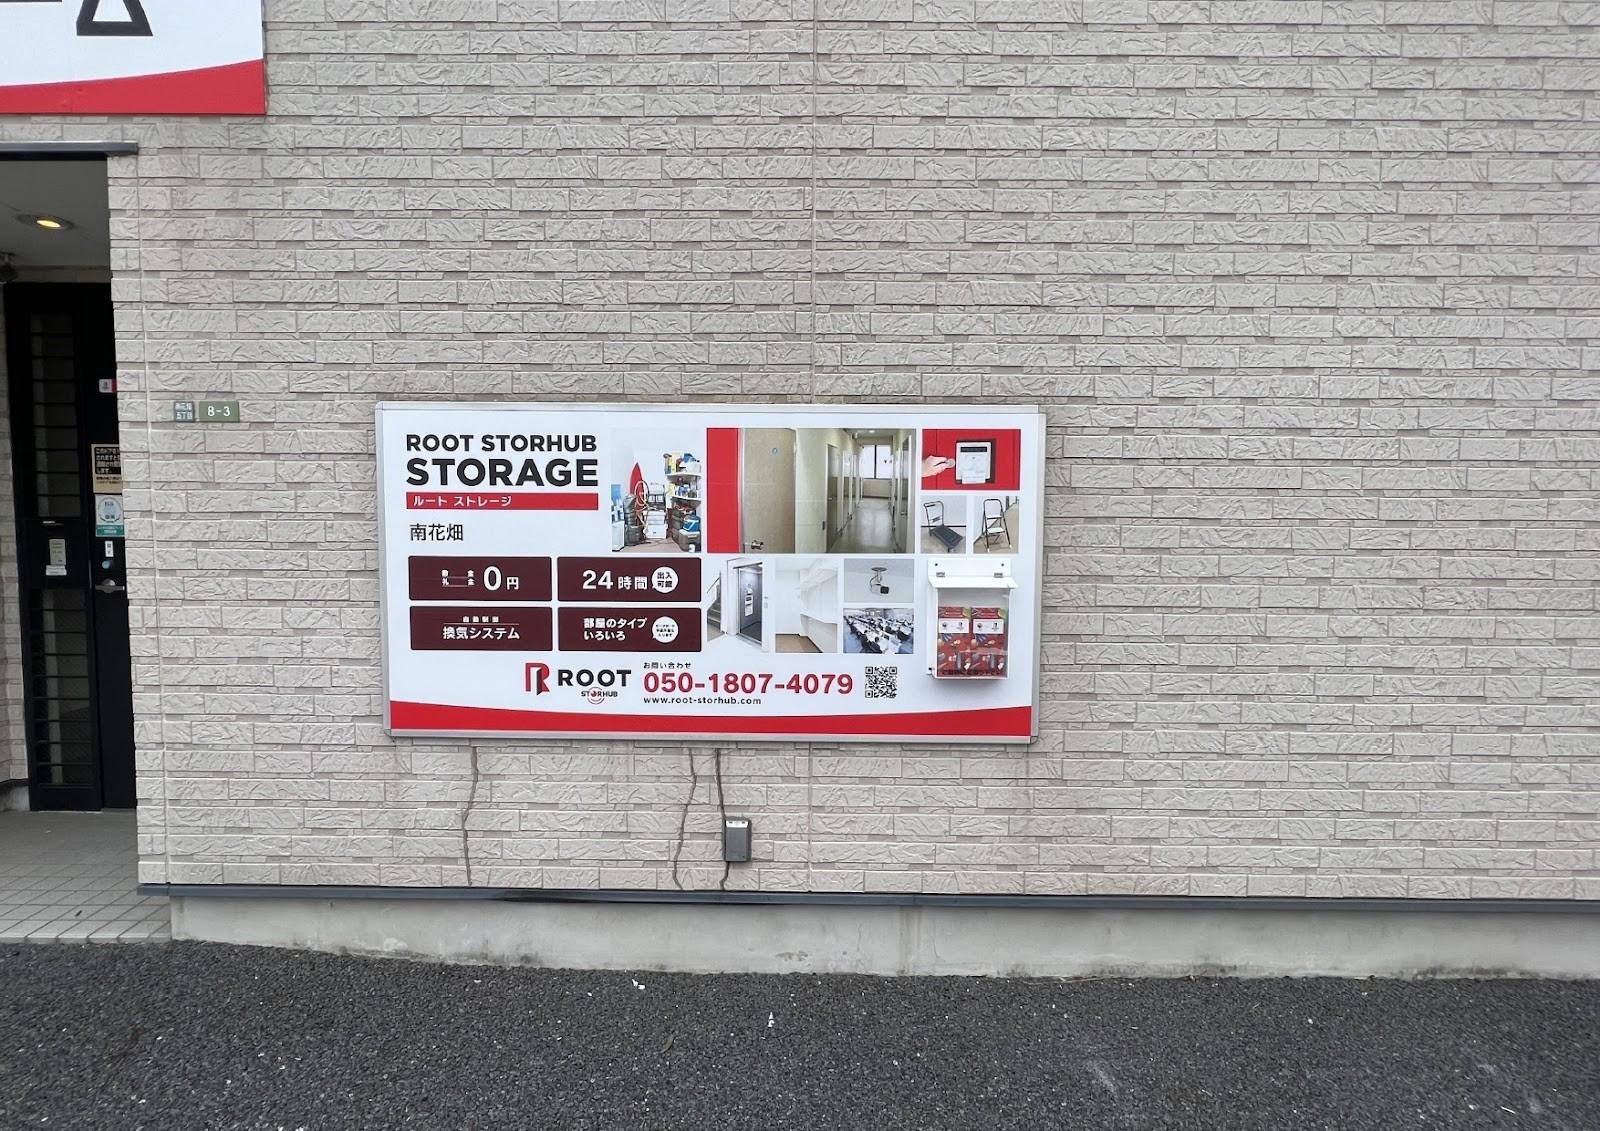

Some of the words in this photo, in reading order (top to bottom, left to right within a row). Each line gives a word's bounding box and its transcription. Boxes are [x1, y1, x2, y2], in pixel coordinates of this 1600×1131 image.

[207, 405, 231, 417] 8-3
[406, 434, 474, 452] ROOT
[481, 434, 597, 452] STORHUB
[406, 458, 599, 487] STORAGE
[413, 495, 448, 507] ルート
[453, 495, 512, 508] ストレージ
[409, 523, 464, 542] 南花畑
[582, 569, 648, 590] 24時間
[657, 571, 673, 580] 出入
[657, 580, 673, 588] 可能
[583, 617, 648, 629] 部屋のタイプ
[442, 626, 520, 640] 換気システム
[583, 630, 626, 641] いろいろ
[643, 661, 692, 669] お問い合わせ
[557, 669, 632, 687] ROOT
[643, 672, 853, 695] 050-1807-4079
[643, 696, 762, 706] www.root-storhub.com
